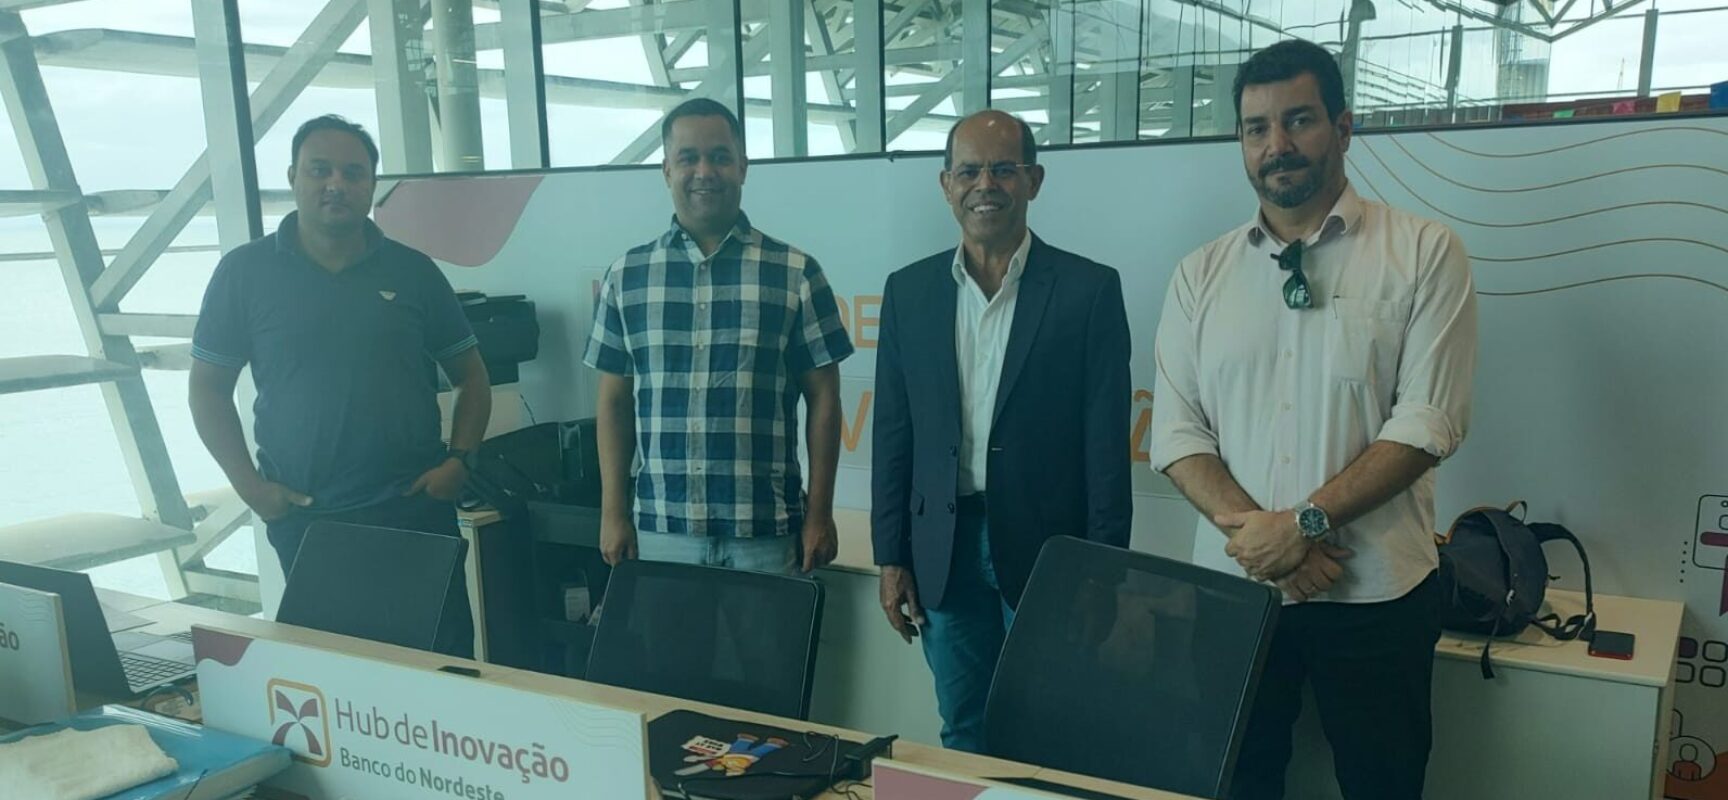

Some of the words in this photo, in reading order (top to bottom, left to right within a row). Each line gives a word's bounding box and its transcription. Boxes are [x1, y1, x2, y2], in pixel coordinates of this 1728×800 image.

[340, 747, 391, 778] Banco
[395, 762, 417, 785] do
[419, 767, 505, 800] Nordeste
[431, 720, 569, 784] Inovação
